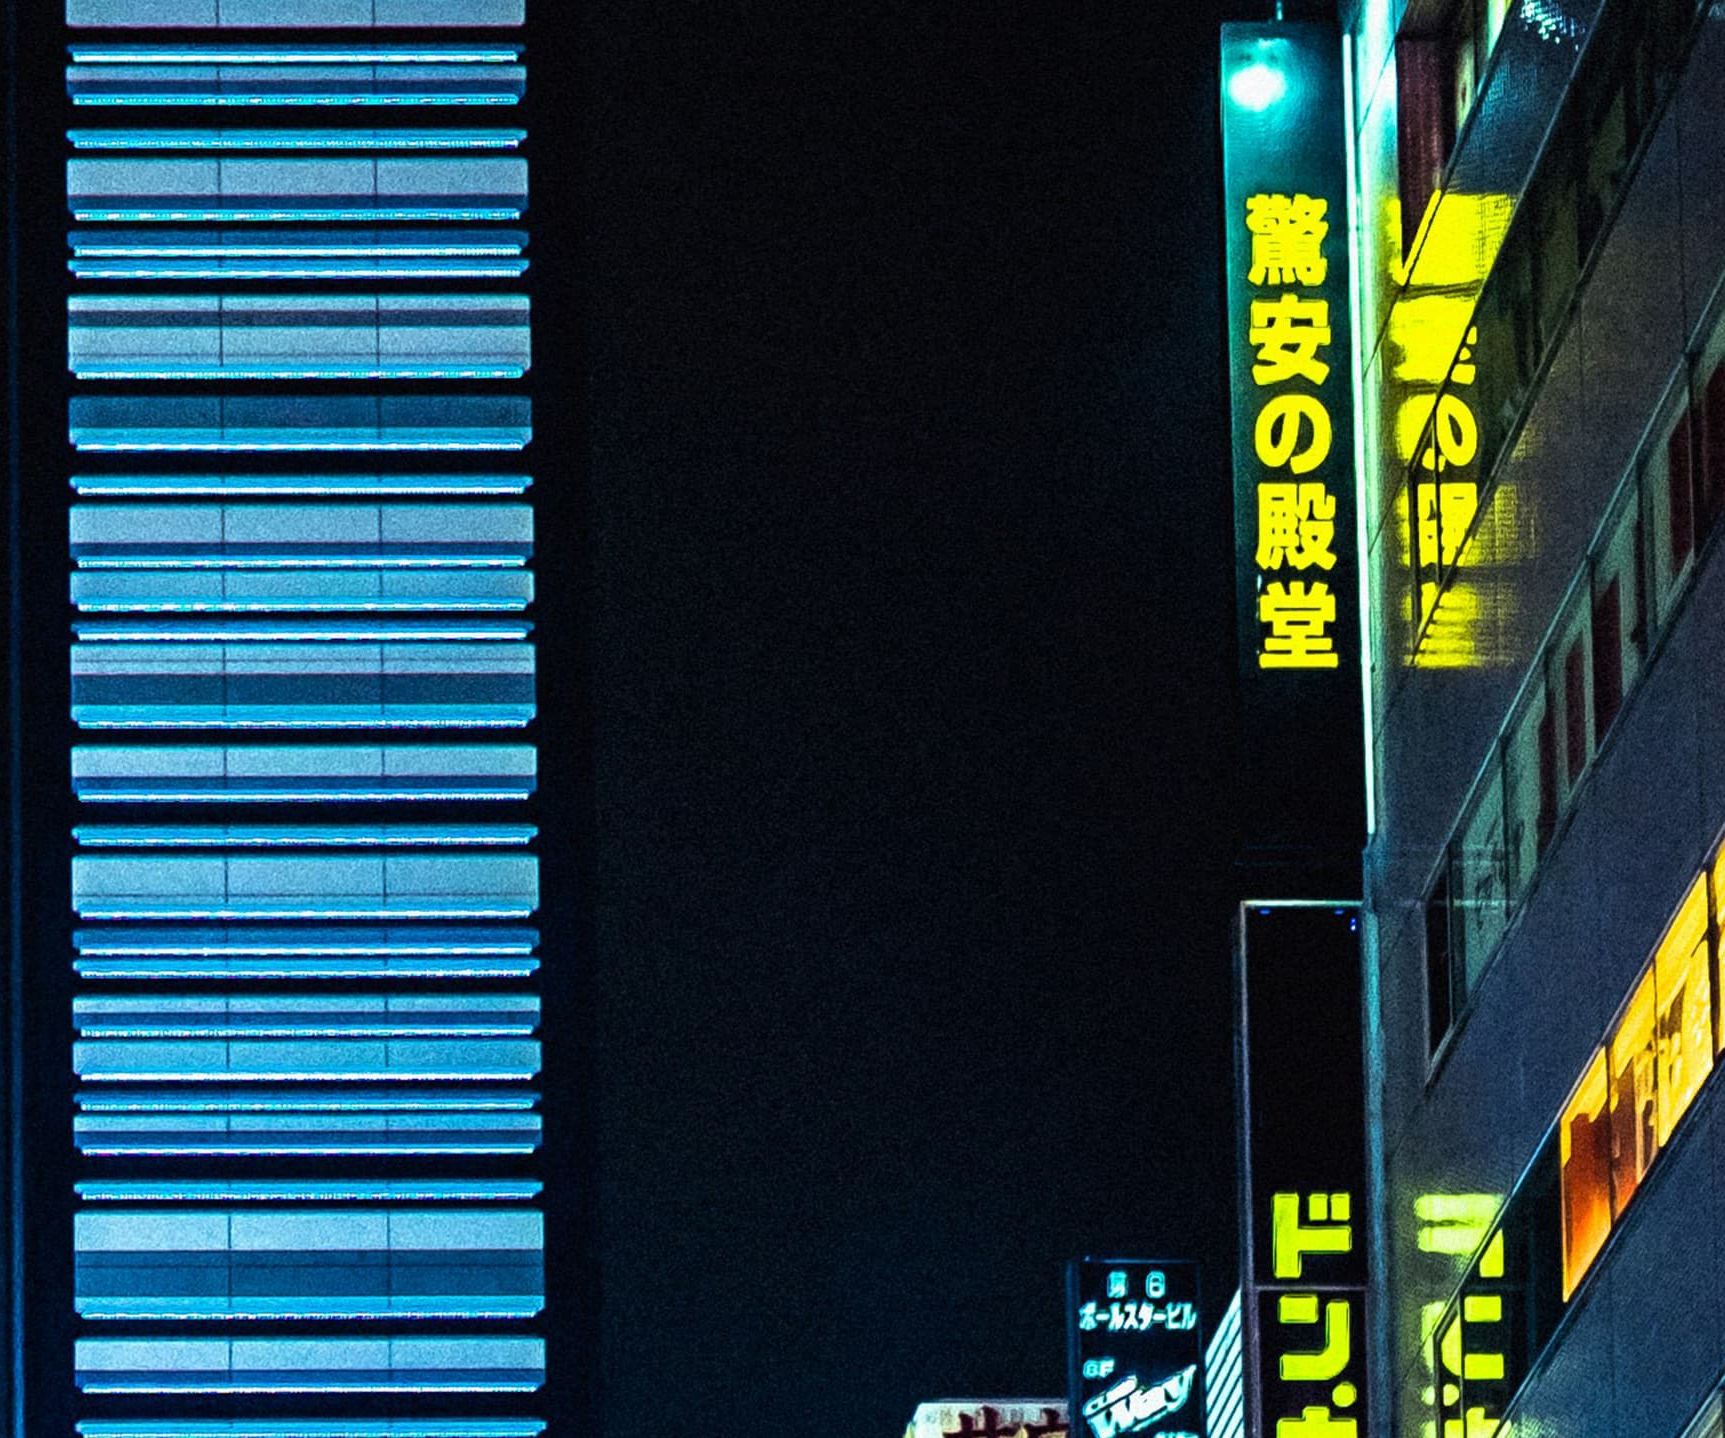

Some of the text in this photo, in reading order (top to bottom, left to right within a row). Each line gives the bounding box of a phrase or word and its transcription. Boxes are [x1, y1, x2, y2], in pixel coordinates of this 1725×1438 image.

[1245, 193, 1338, 669] 驚安の殿堂
